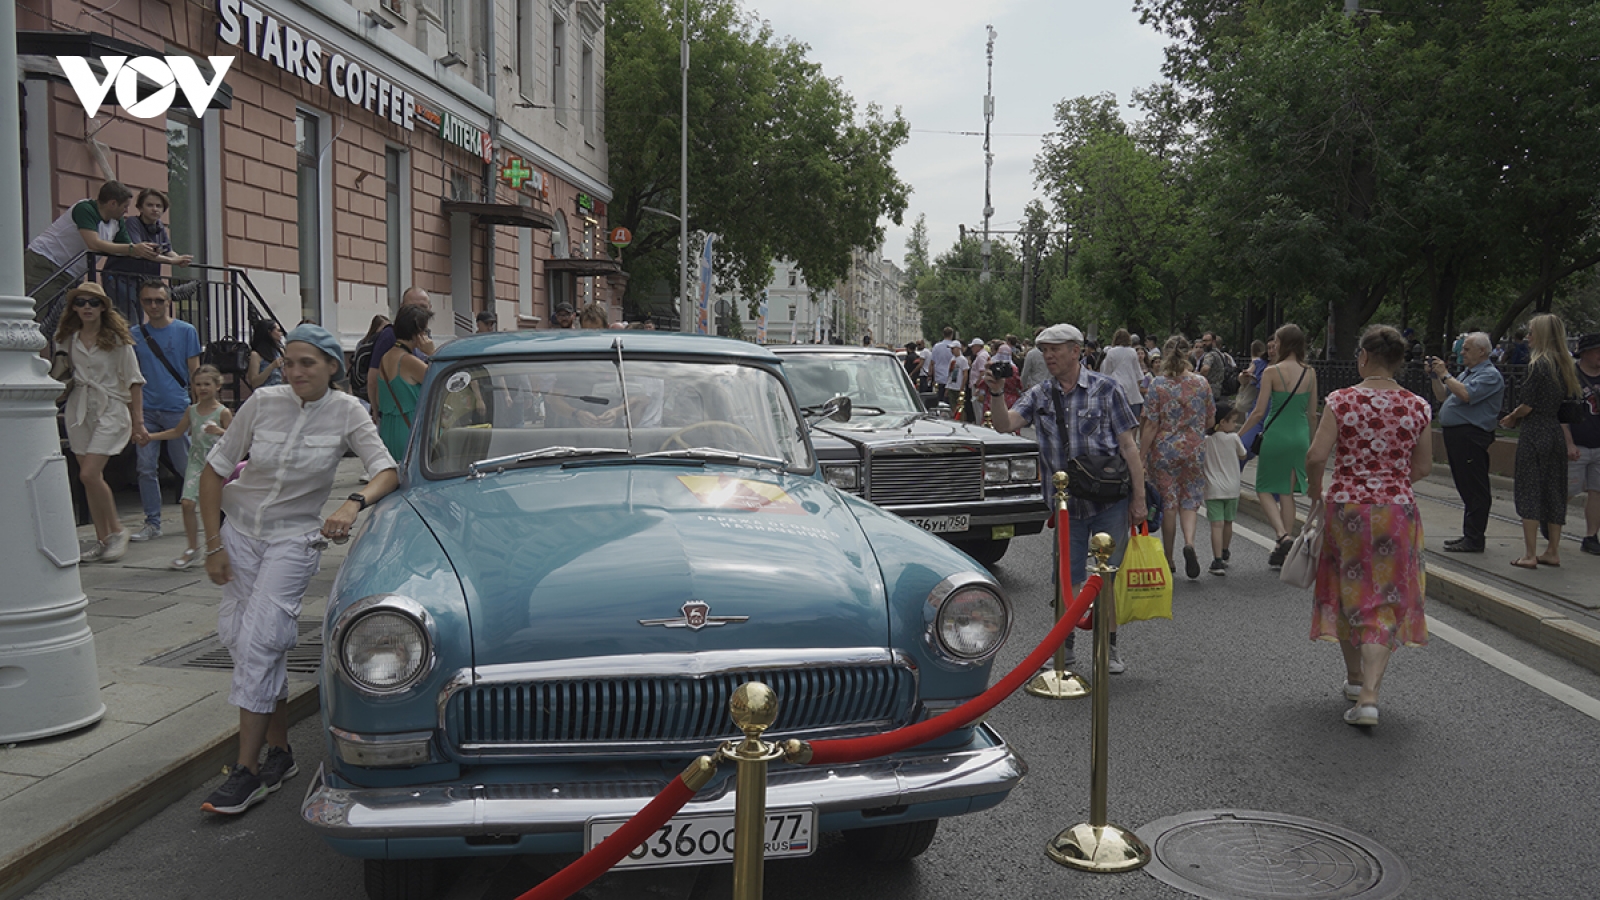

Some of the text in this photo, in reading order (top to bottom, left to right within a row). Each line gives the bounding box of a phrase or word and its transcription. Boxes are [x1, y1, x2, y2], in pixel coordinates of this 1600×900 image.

[218, 0, 415, 132] STARS COFFEE
[443, 112, 484, 158] АПТЕКА
[949, 515, 967, 527] 750
[1129, 571, 1164, 585] BILLA
[764, 840, 789, 852] RUS
